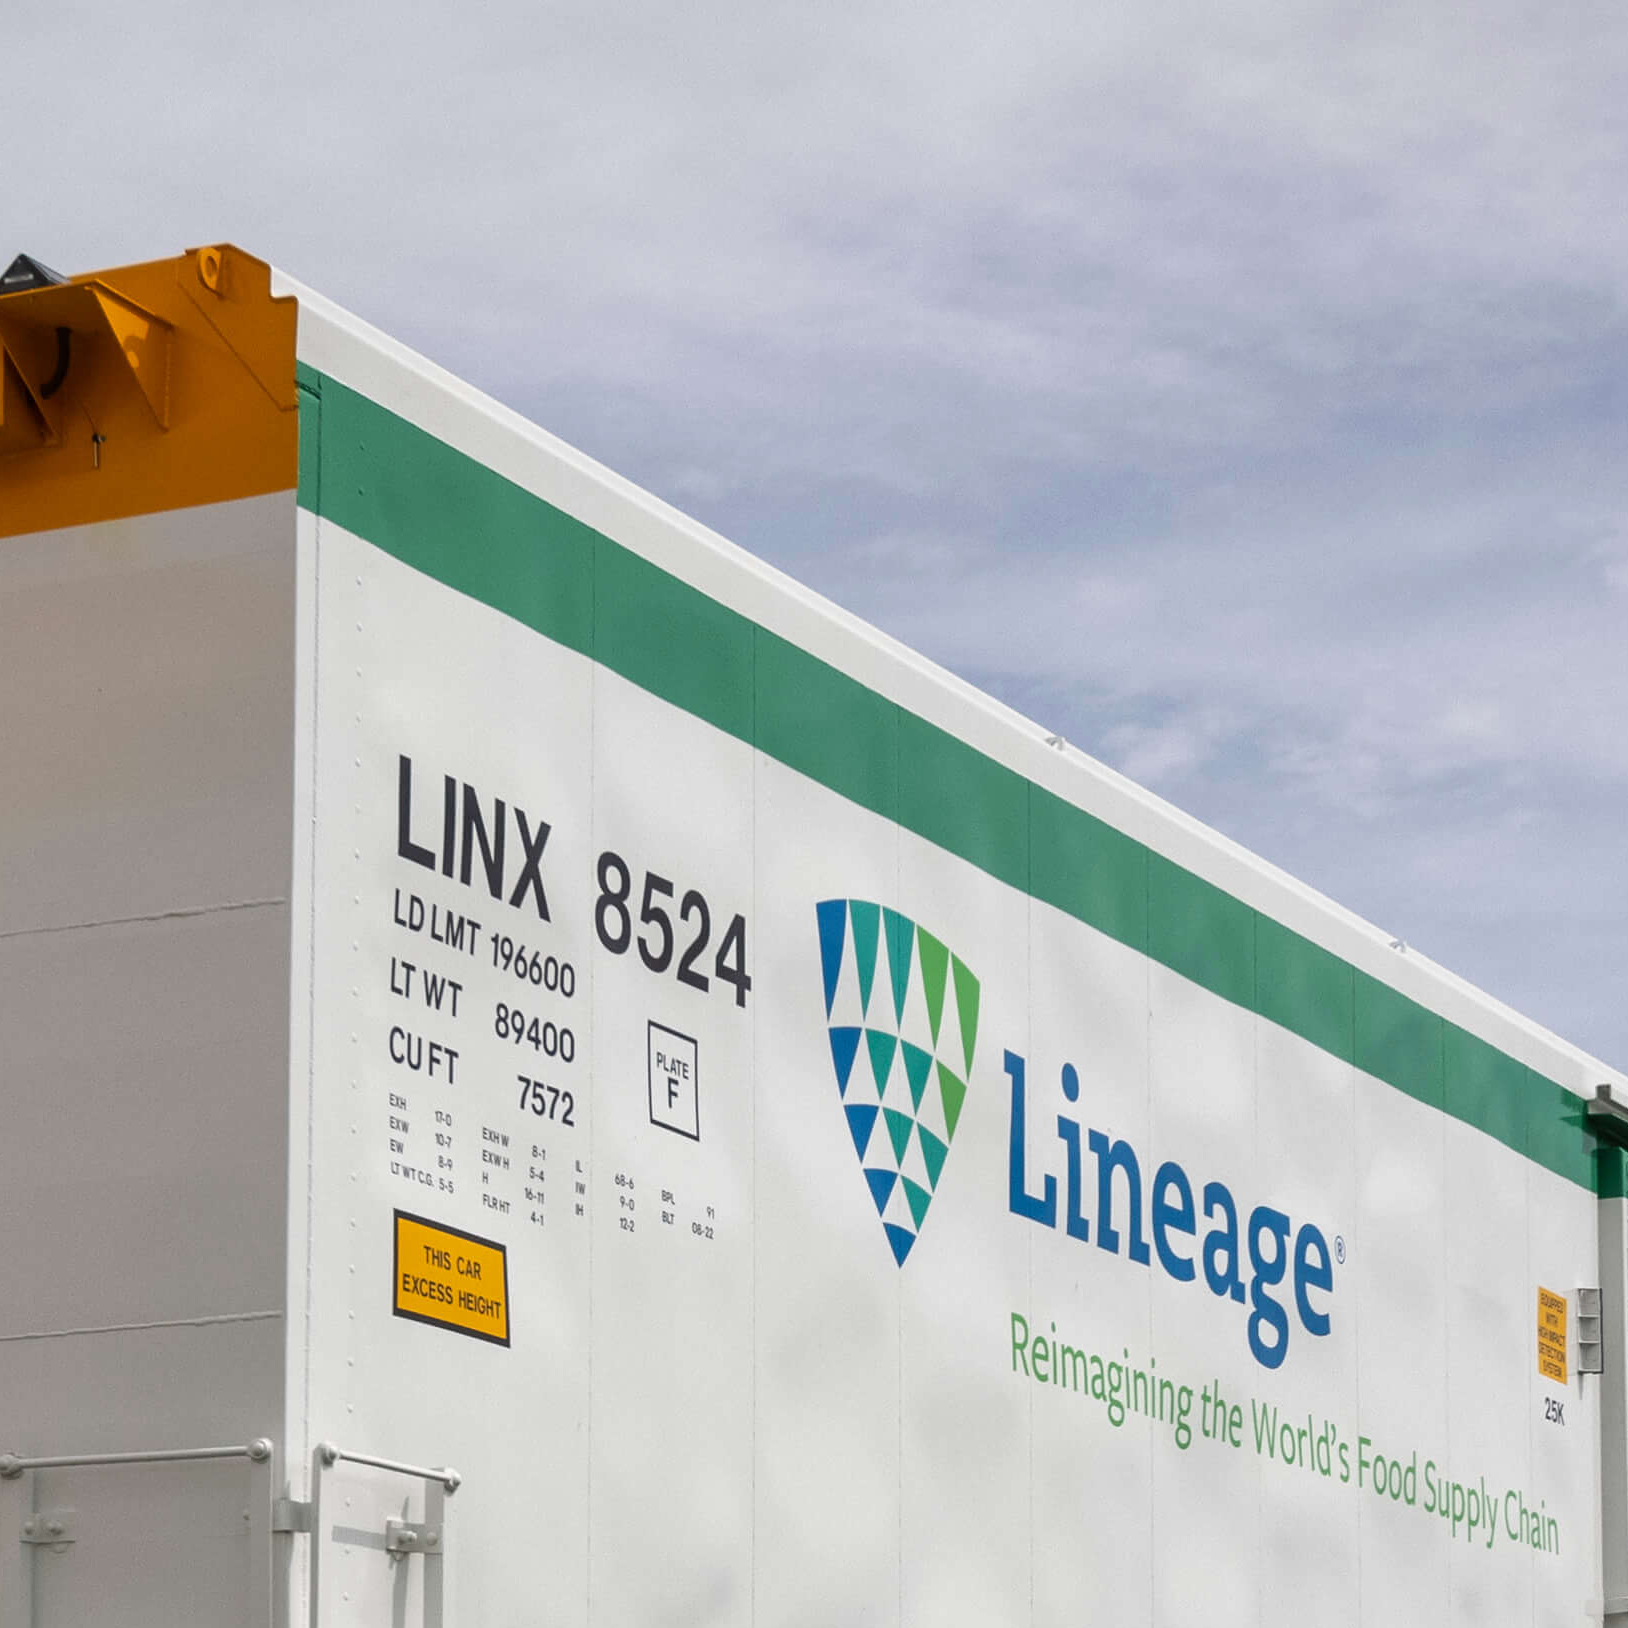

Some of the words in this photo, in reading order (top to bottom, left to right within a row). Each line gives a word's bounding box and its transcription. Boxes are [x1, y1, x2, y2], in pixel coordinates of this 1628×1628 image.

[397, 754, 552, 923] LINX
[594, 851, 752, 1009] 8524
[394, 887, 425, 932] LD
[430, 902, 481, 956] LMT
[491, 932, 576, 999] 196600
[390, 957, 417, 999] LT
[424, 970, 463, 1018] WT
[495, 1003, 575, 1064] 89400
[389, 1026, 421, 1071] CU
[428, 1041, 459, 1085] FT
[517, 1075, 575, 1127] 7572
[656, 1051, 689, 1080] PLATE
[389, 1093, 407, 1111] EXH
[667, 1077, 680, 1110] F
[389, 1116, 410, 1134] EXW
[390, 1139, 404, 1155] EW
[423, 1245, 451, 1271] THIS
[456, 1256, 482, 1281] CAR
[402, 1273, 453, 1305] EXCESS
[458, 1291, 502, 1320] HEIGHT
[1544, 1396, 1565, 1426] 25K
[1010, 1311, 1194, 1450] Reimagining
[1200, 1377, 1243, 1448] the
[1357, 1435, 1416, 1506] Food
[1423, 1457, 1497, 1550] Supply
[1503, 1487, 1560, 1555] Chain
